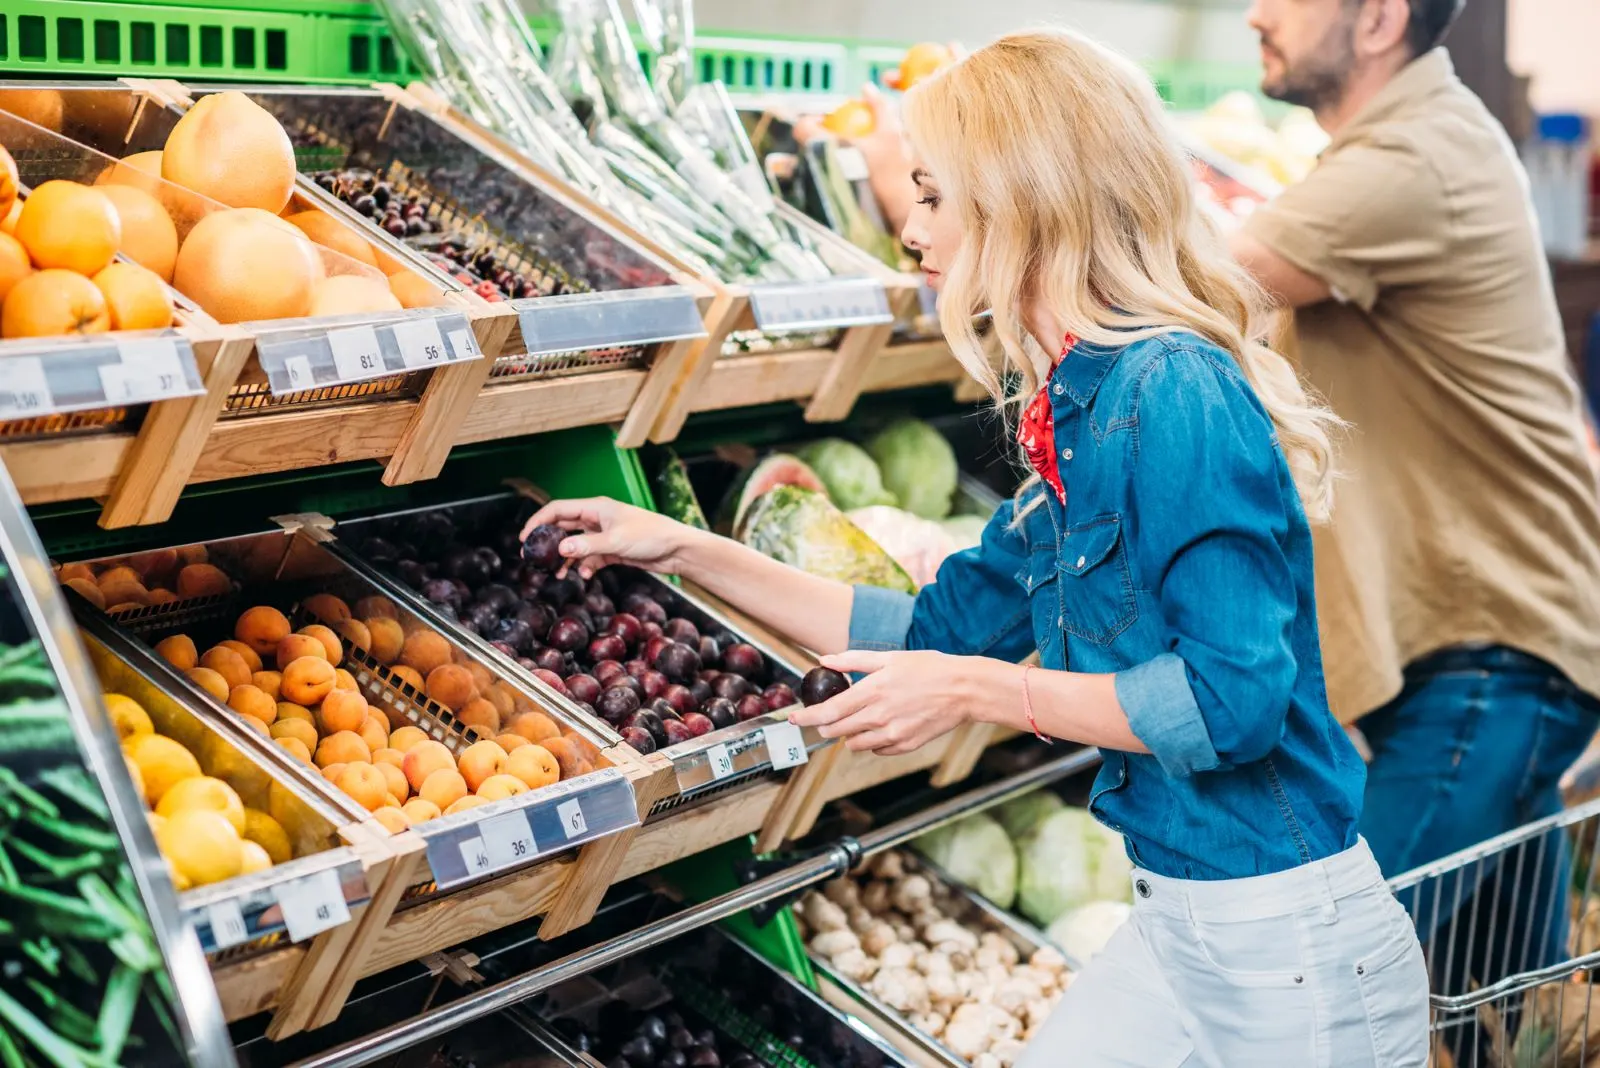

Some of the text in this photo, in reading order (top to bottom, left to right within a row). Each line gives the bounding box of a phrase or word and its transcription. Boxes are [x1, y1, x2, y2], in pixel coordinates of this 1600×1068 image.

[425, 345, 439, 360] 56
[465, 339, 473, 353] 4
[360, 354, 374, 369] 81
[787, 747, 800, 761] 50
[719, 757, 730, 773] 30
[571, 812, 582, 830] 67
[511, 840, 526, 856] 36
[476, 853, 489, 869] 46
